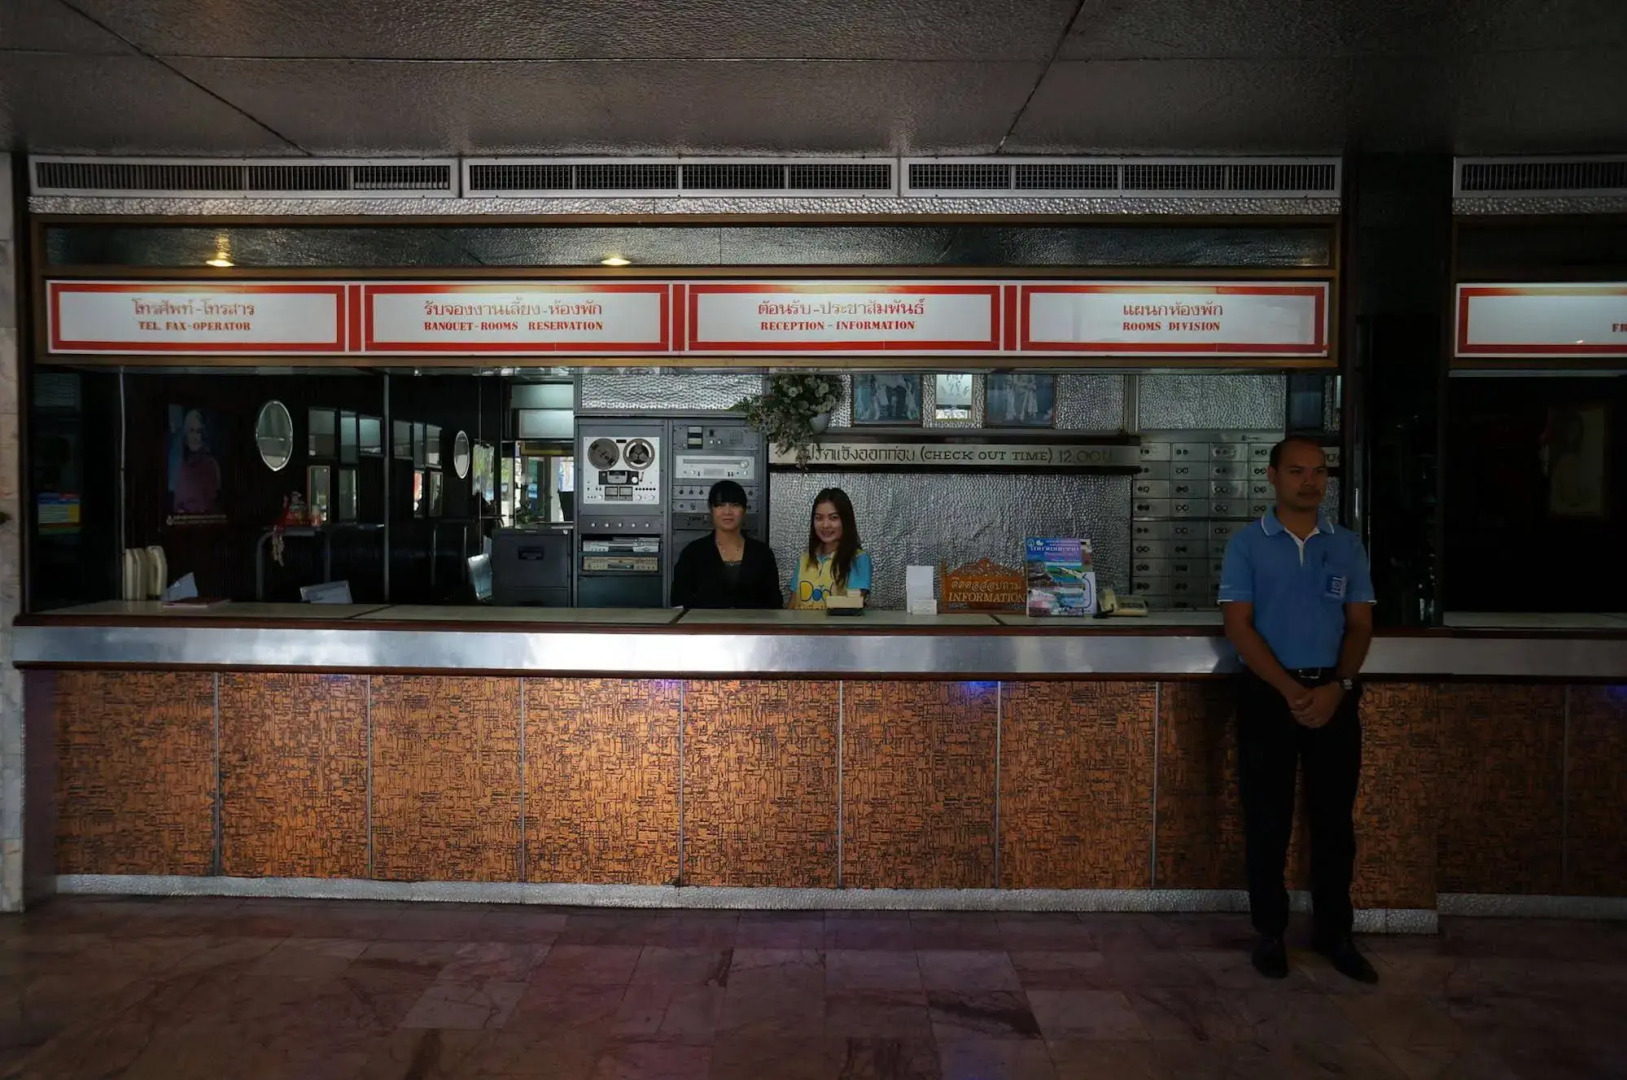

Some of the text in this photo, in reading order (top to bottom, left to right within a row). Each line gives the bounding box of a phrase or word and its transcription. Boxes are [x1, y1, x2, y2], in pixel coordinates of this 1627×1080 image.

[1123, 301, 1223, 316] แผนกห้องพัก
[528, 321, 603, 331] RESERVATION
[1123, 322, 1221, 331] ROOMS DIVISION
[920, 446, 974, 463] (CHECK
[978, 451, 1007, 460] OUT
[1012, 448, 1053, 463] TIME)
[948, 592, 1026, 603] INFORMATION
